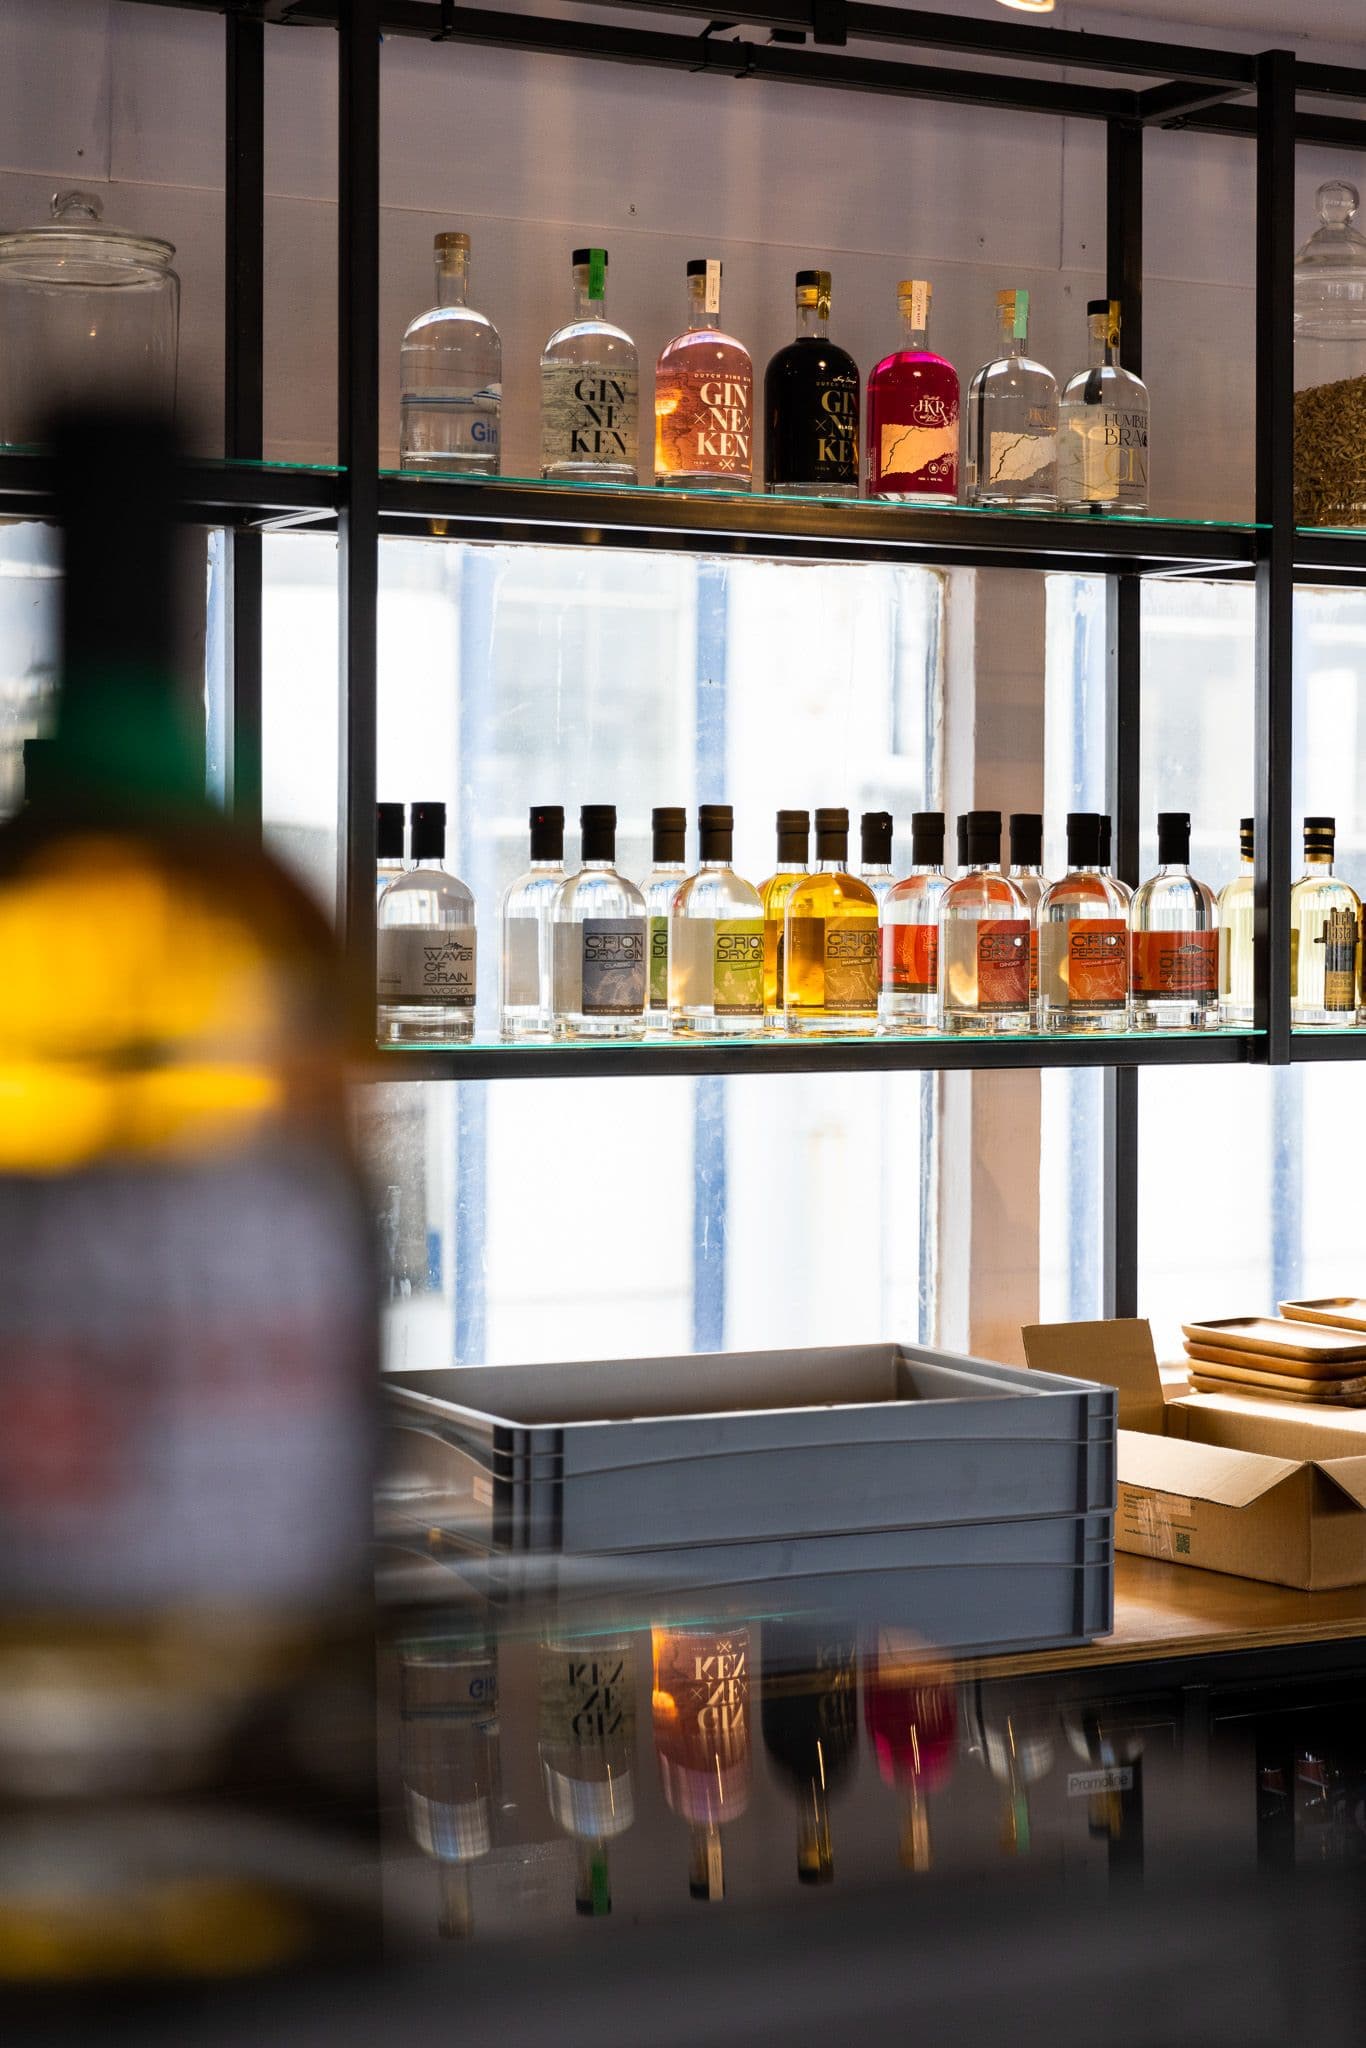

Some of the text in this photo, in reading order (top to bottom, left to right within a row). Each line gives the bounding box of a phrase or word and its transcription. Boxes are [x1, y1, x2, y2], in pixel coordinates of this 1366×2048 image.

[574, 379, 627, 405] GIN
[700, 381, 749, 409] GIN
[583, 403, 622, 429] NE
[914, 399, 949, 426] JKR
[707, 407, 744, 433] NE
[471, 421, 497, 444] Gin
[570, 429, 629, 456] KEN
[697, 432, 750, 459] KEN
[585, 935, 643, 948] ORION
[1072, 935, 1126, 947] ORION
[424, 950, 473, 961] WAVES
[585, 949, 643, 960] DRY GIN
[717, 949, 750, 960] DRY
[827, 945, 860, 956] DRY
[424, 962, 447, 972] OF
[424, 972, 469, 983] GRAIN
[430, 986, 470, 995] WODKA
